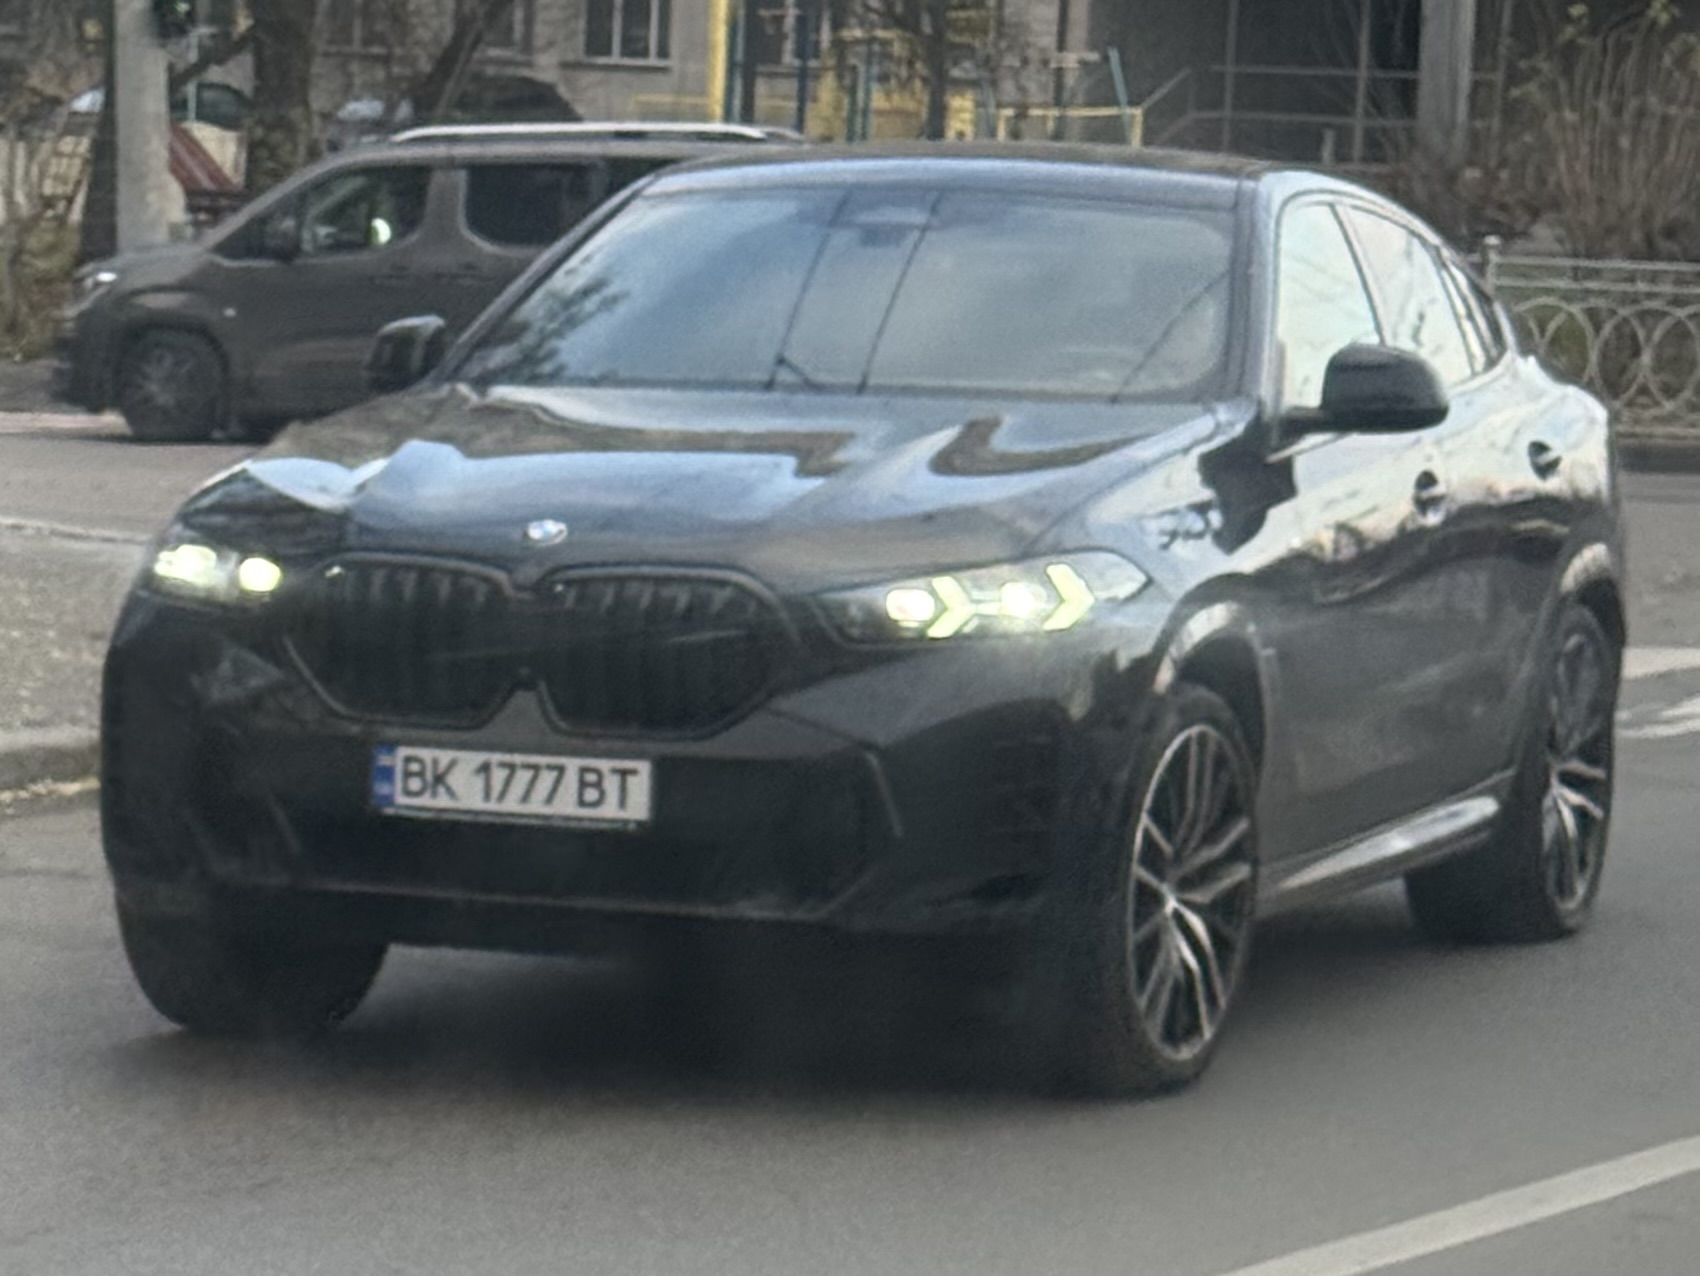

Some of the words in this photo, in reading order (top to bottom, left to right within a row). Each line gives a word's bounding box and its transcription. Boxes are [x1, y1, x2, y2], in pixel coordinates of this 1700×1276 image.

[401, 755, 458, 800] BK
[475, 760, 567, 805] 1777
[577, 766, 639, 810] BT
